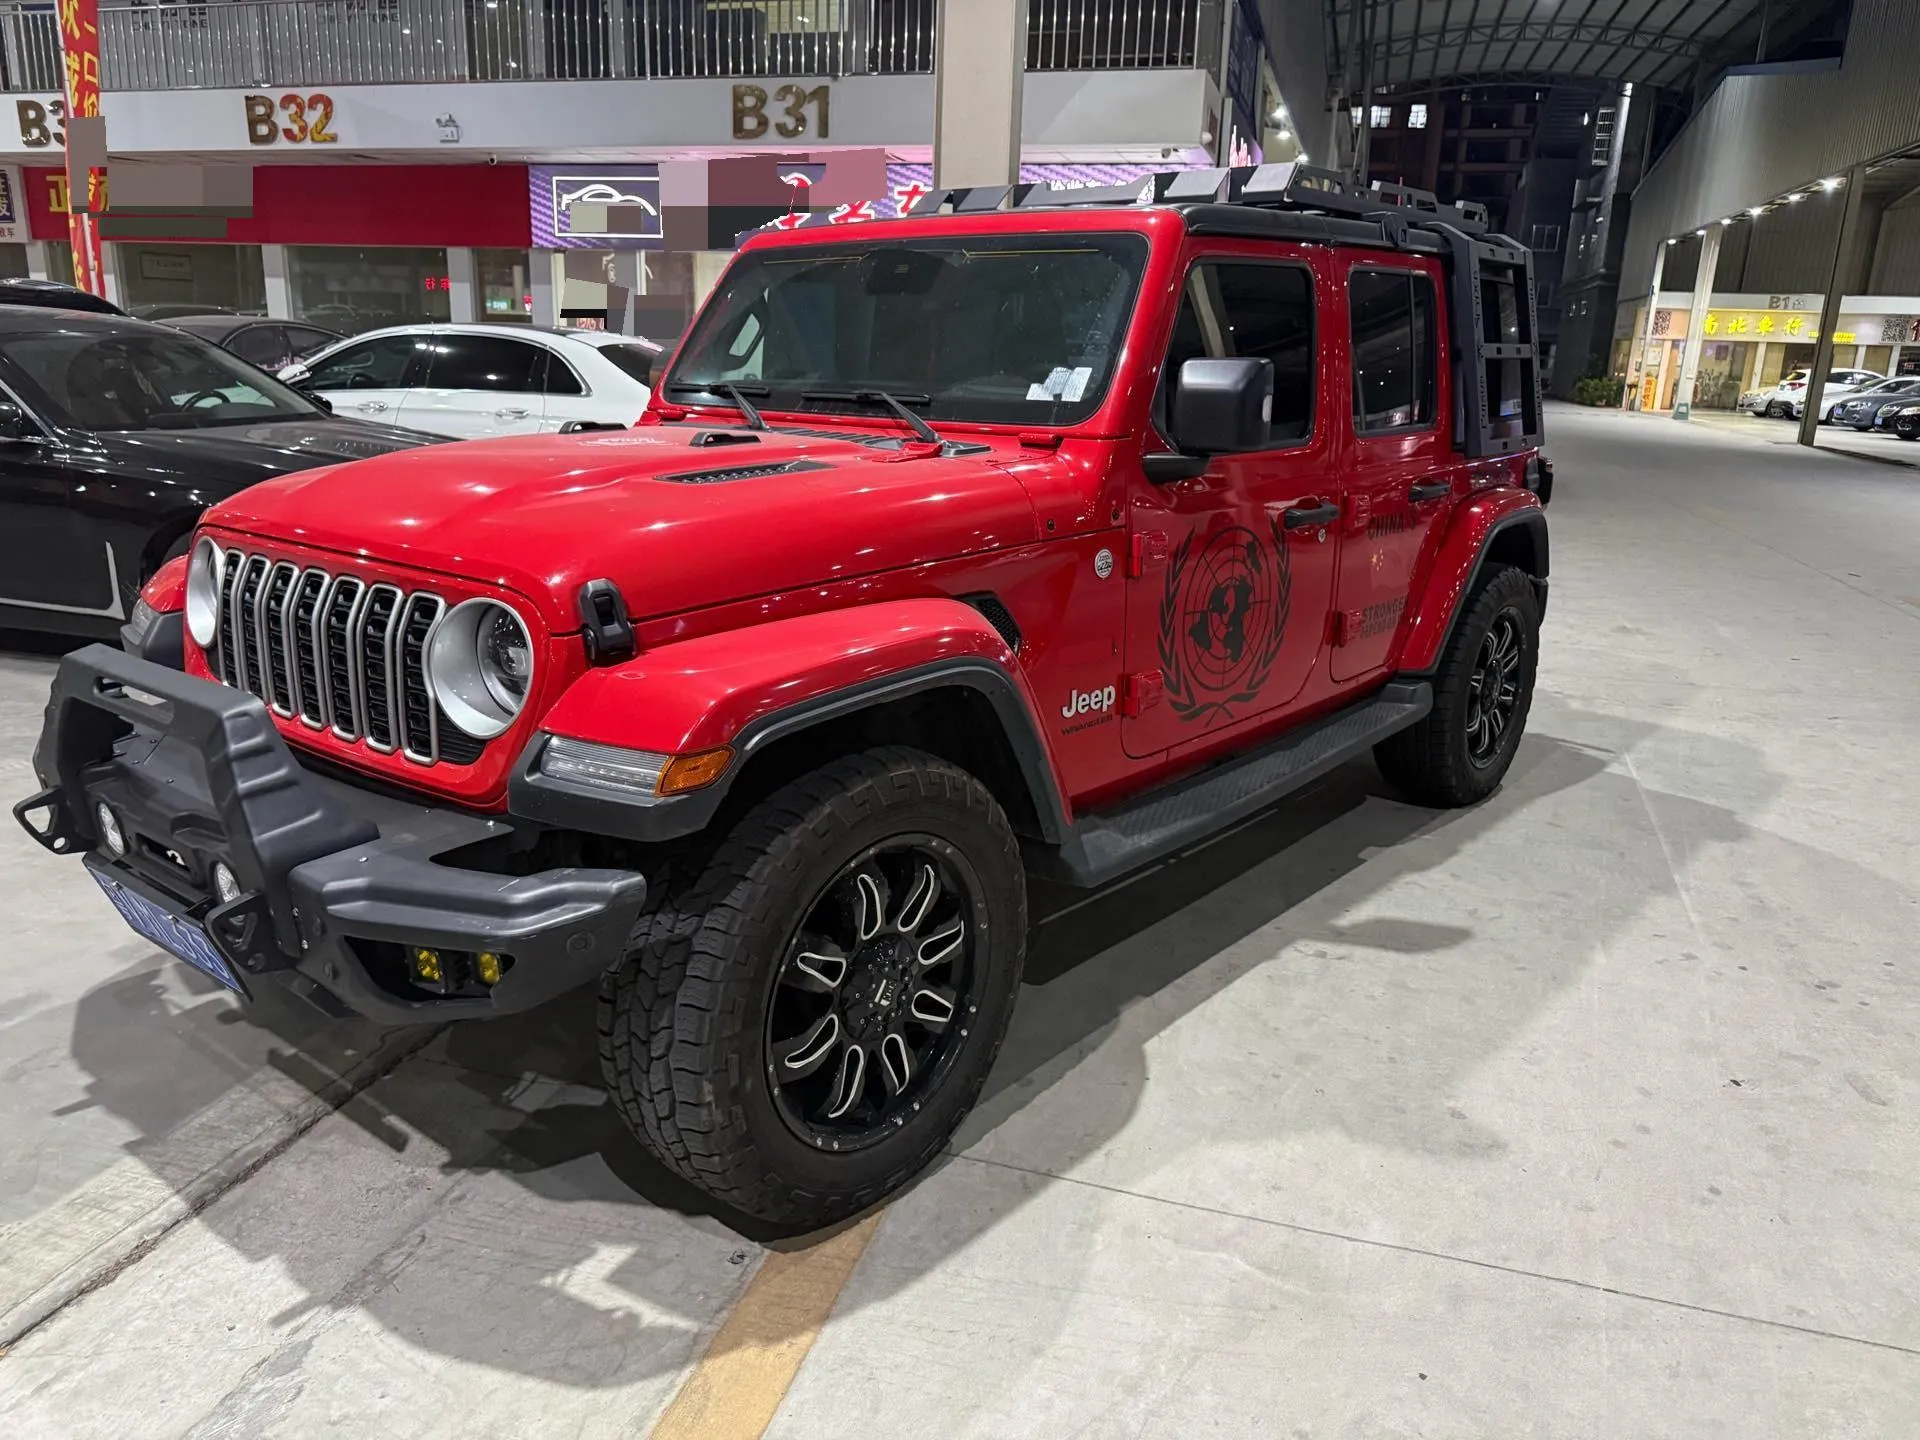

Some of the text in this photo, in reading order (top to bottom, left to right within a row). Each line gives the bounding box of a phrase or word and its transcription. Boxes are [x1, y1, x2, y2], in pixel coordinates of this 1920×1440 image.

[16, 100, 66, 148] B3
[245, 94, 338, 144] B32
[732, 84, 830, 139] B31
[1062, 685, 1116, 718] Jeep
